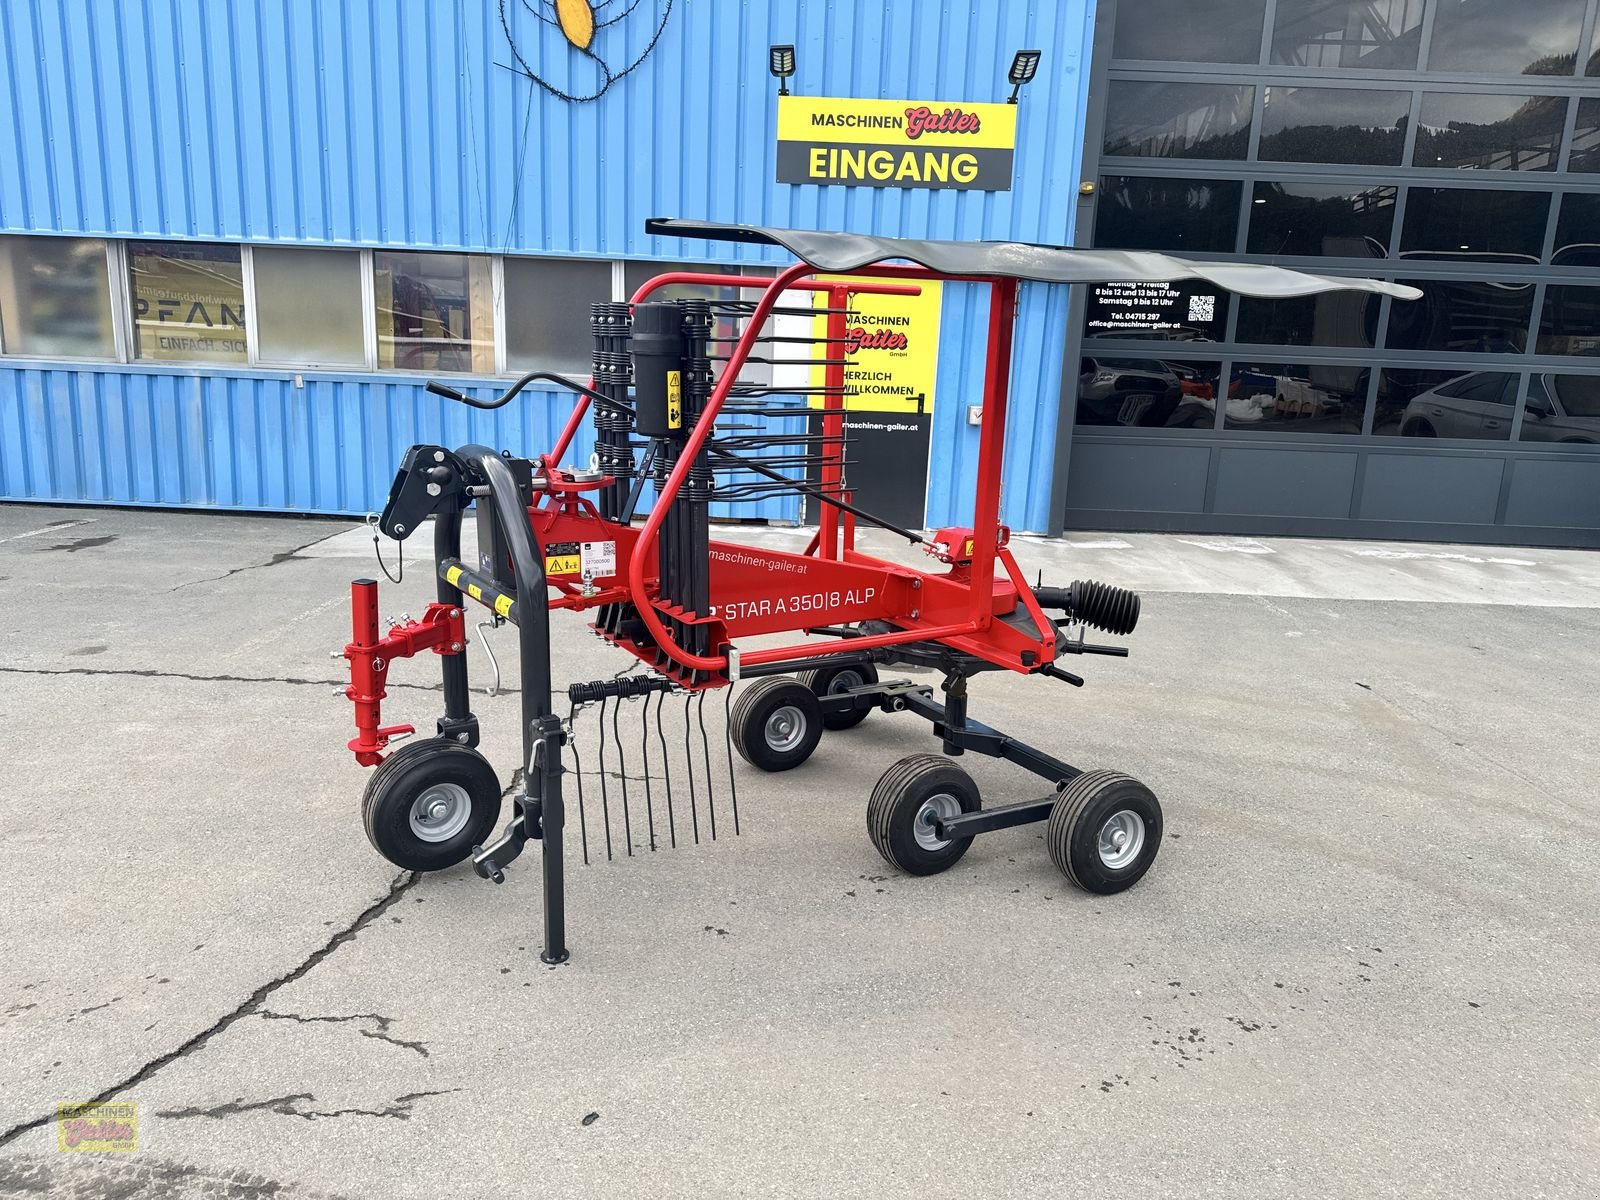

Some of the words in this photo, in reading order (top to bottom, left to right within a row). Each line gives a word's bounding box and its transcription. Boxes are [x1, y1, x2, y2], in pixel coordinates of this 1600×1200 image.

[811, 113, 903, 129] MASCHINEN
[905, 107, 980, 139] Gailer
[809, 148, 979, 183] EINGANG
[1101, 288, 1113, 296] bis
[1114, 288, 1121, 296] 12
[1138, 289, 1145, 297] 13
[1146, 289, 1157, 297] bis
[1099, 297, 1132, 306] Samstag
[1140, 298, 1151, 306] bis
[845, 315, 910, 326] MASCHINEN
[1111, 312, 1124, 320] Tel.
[845, 327, 908, 355] Gailer
[843, 371, 892, 381] HERZLICH
[843, 384, 914, 396] WILLKOMMEN
[822, 421, 919, 432] maschinen-gailer.at
[709, 549, 808, 575] maschinen-gailer.at
[725, 599, 771, 621] STAR
[774, 598, 786, 614] A
[844, 587, 875, 606] ALP
